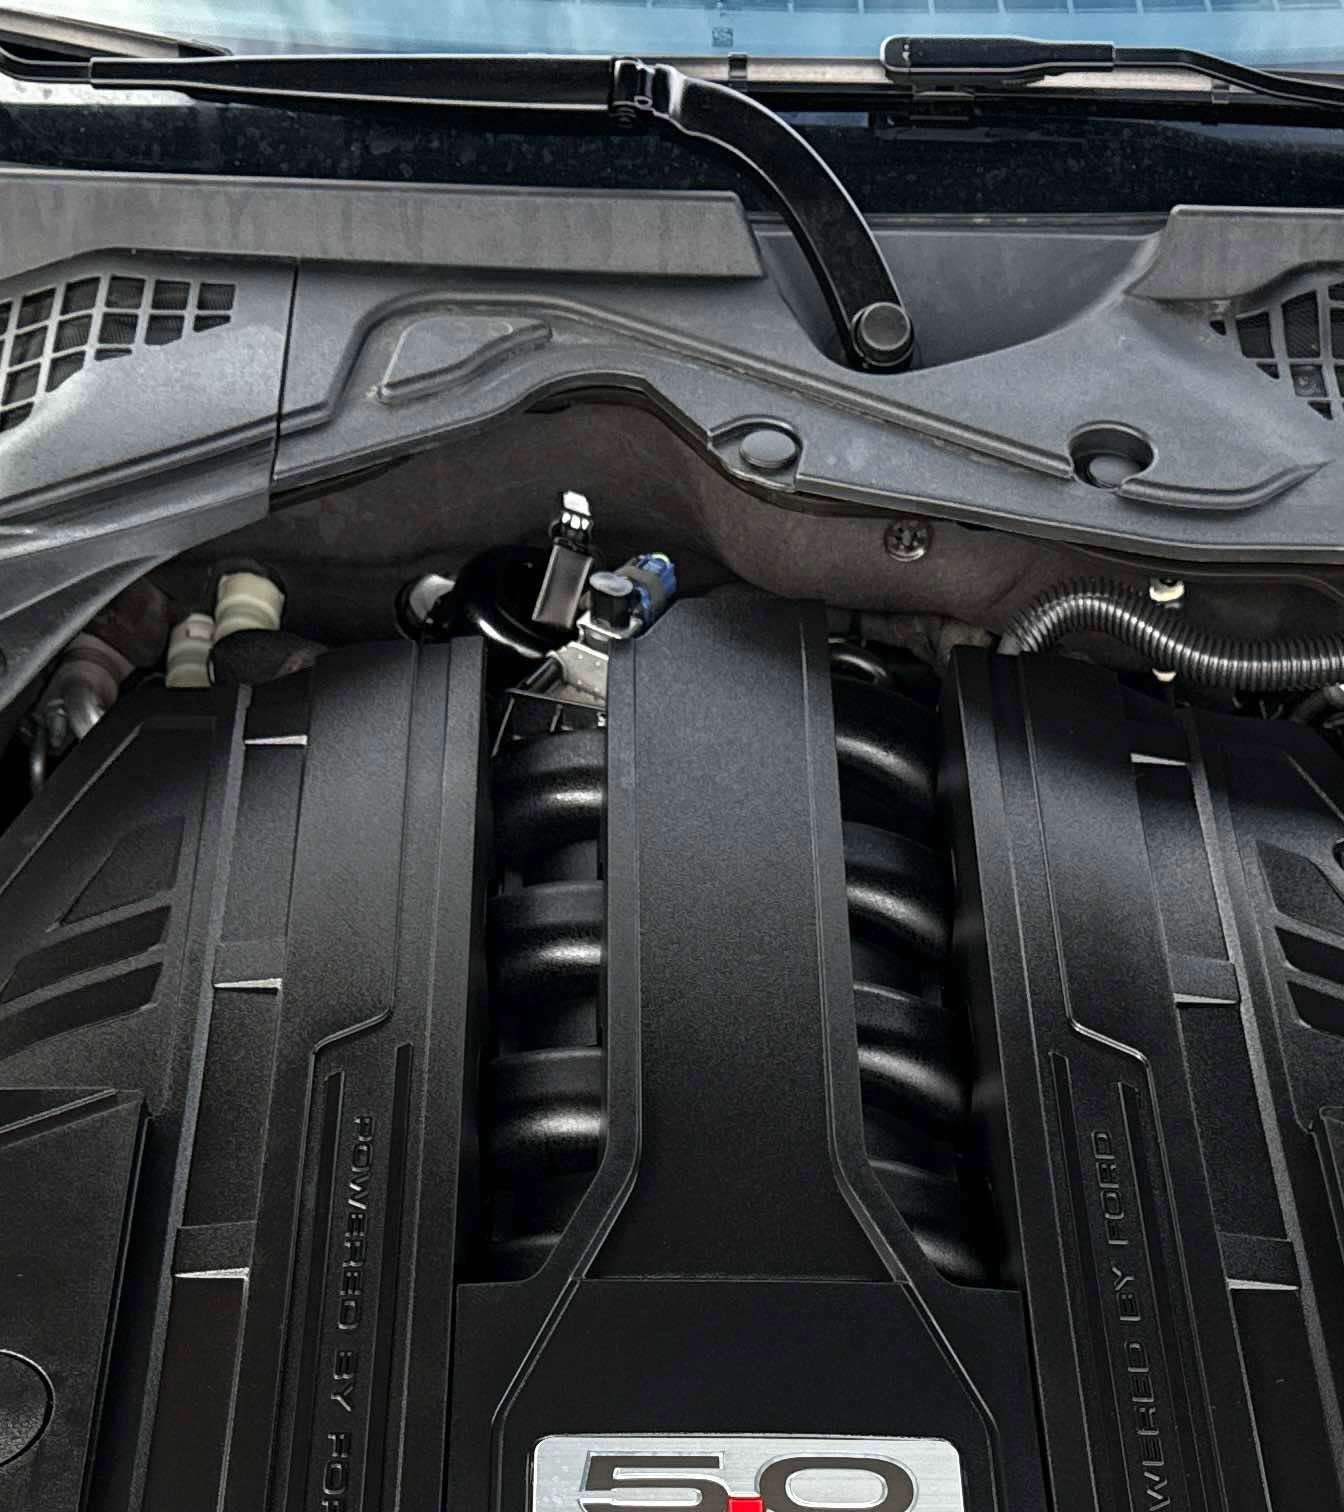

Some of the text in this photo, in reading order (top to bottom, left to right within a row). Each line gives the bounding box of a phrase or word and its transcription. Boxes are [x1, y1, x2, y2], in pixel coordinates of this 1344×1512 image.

[337, 1114, 375, 1331] POWERED
[1090, 1130, 1130, 1246] FORD
[1111, 1264, 1142, 1323] BY
[330, 1350, 358, 1413] BY
